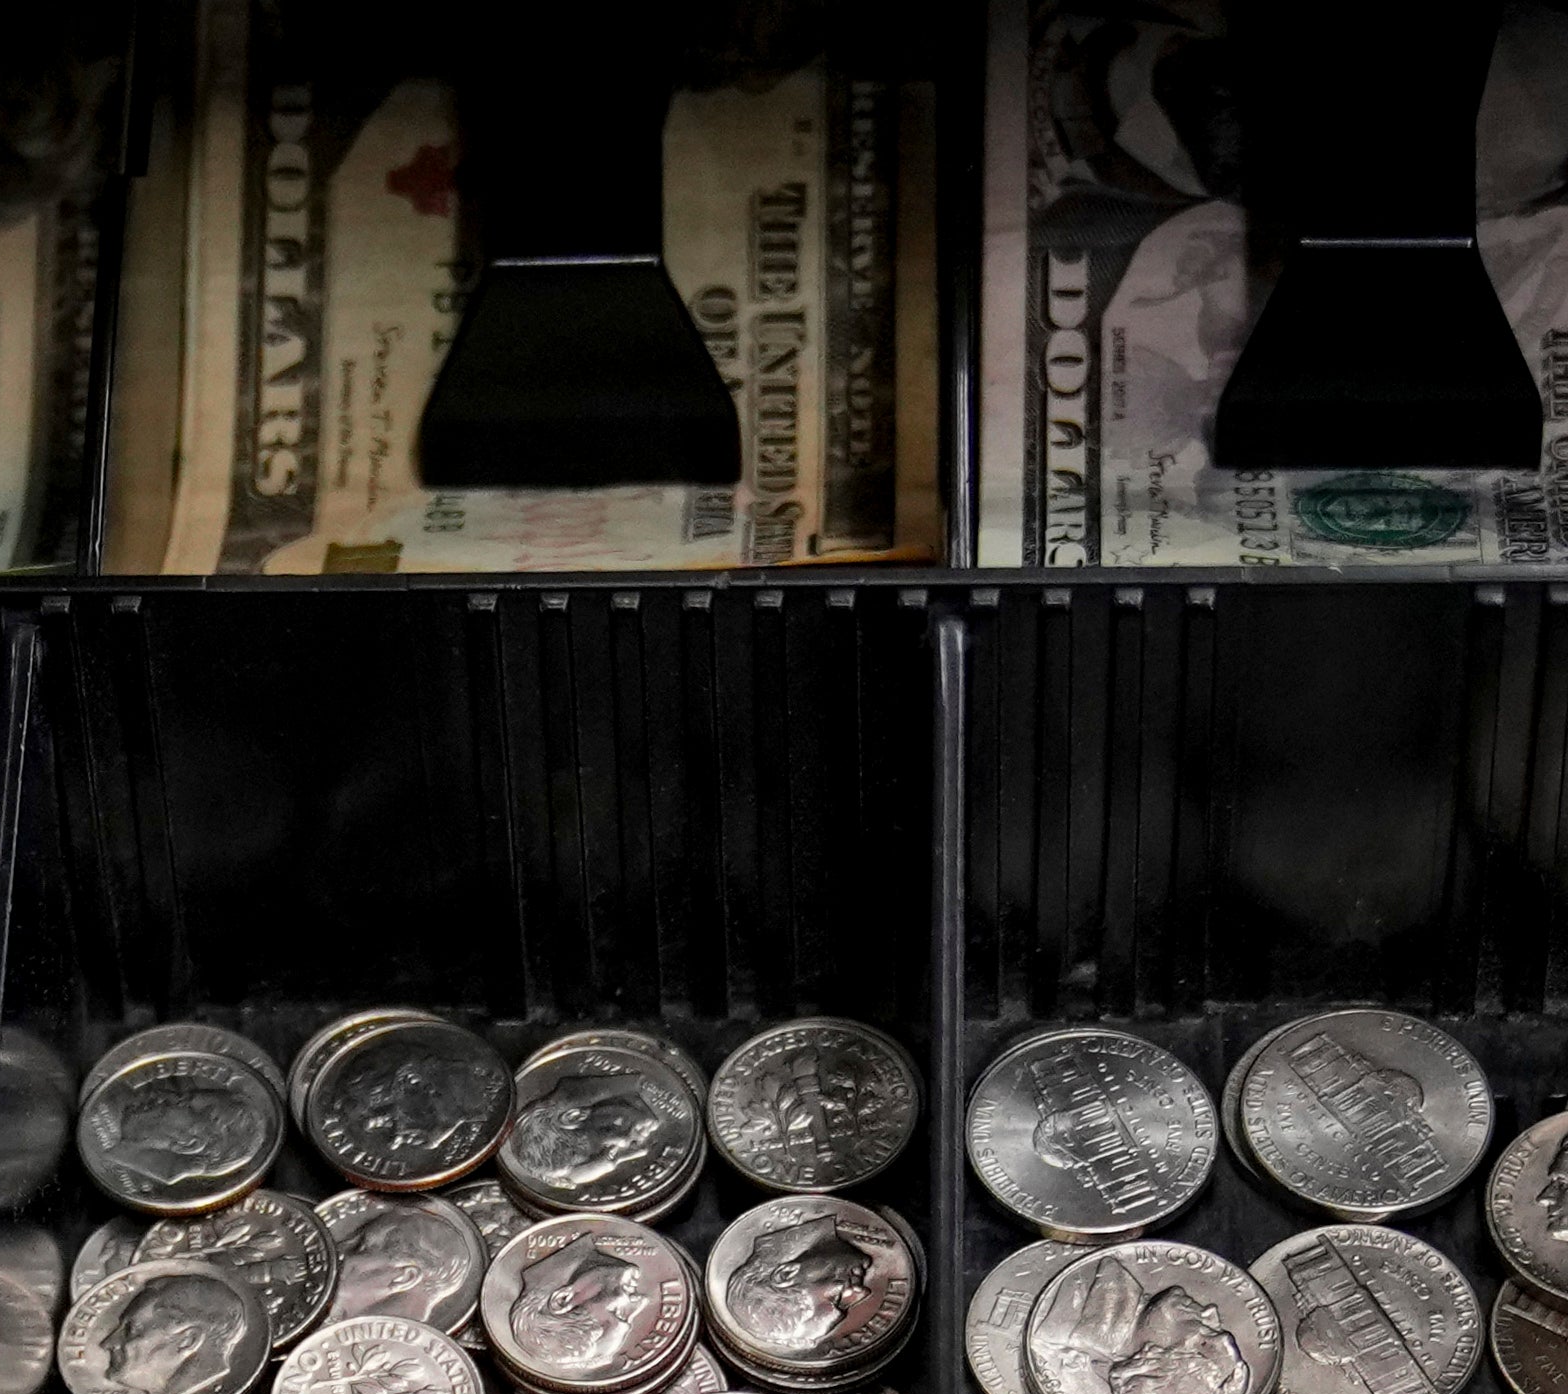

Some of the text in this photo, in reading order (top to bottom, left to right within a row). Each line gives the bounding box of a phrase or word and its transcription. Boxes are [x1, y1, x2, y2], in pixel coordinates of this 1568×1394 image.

[253, 80, 314, 497] DOLLARS
[847, 80, 875, 465] RESERVE NOTE
[750, 182, 806, 495] THE UNITED
[1040, 249, 1090, 568] DOLLARS
[126, 1058, 246, 1091] LIBERTY
[715, 1076, 744, 1148] UNITED
[734, 1029, 810, 1077] STATES
[818, 1030, 847, 1049] OF
[1124, 1068, 1183, 1153] FIVE CENTS
[1161, 1060, 1186, 1084] OF
[1181, 1082, 1214, 1142] STATES
[1381, 1015, 1491, 1128] E PLURIBUS UNUM
[971, 1097, 998, 1145] UNUM
[1247, 1115, 1426, 1207] STATES OF AMERICA
[1295, 1142, 1352, 1179] CENTS
[750, 1152, 815, 1185] ONE
[1503, 1135, 1540, 1193] TRUST
[65, 1273, 140, 1366] LIBERTY
[334, 1321, 420, 1347] UNITED
[622, 1277, 684, 1370] LIBERTY
[827, 1276, 909, 1358] LIBERTY
[1135, 1246, 1278, 1353] IN GOD WE TRUST
[1445, 1270, 1478, 1328] STATES
[969, 1333, 1006, 1391] UNITED
[1533, 1353, 1564, 1386] FIVE
